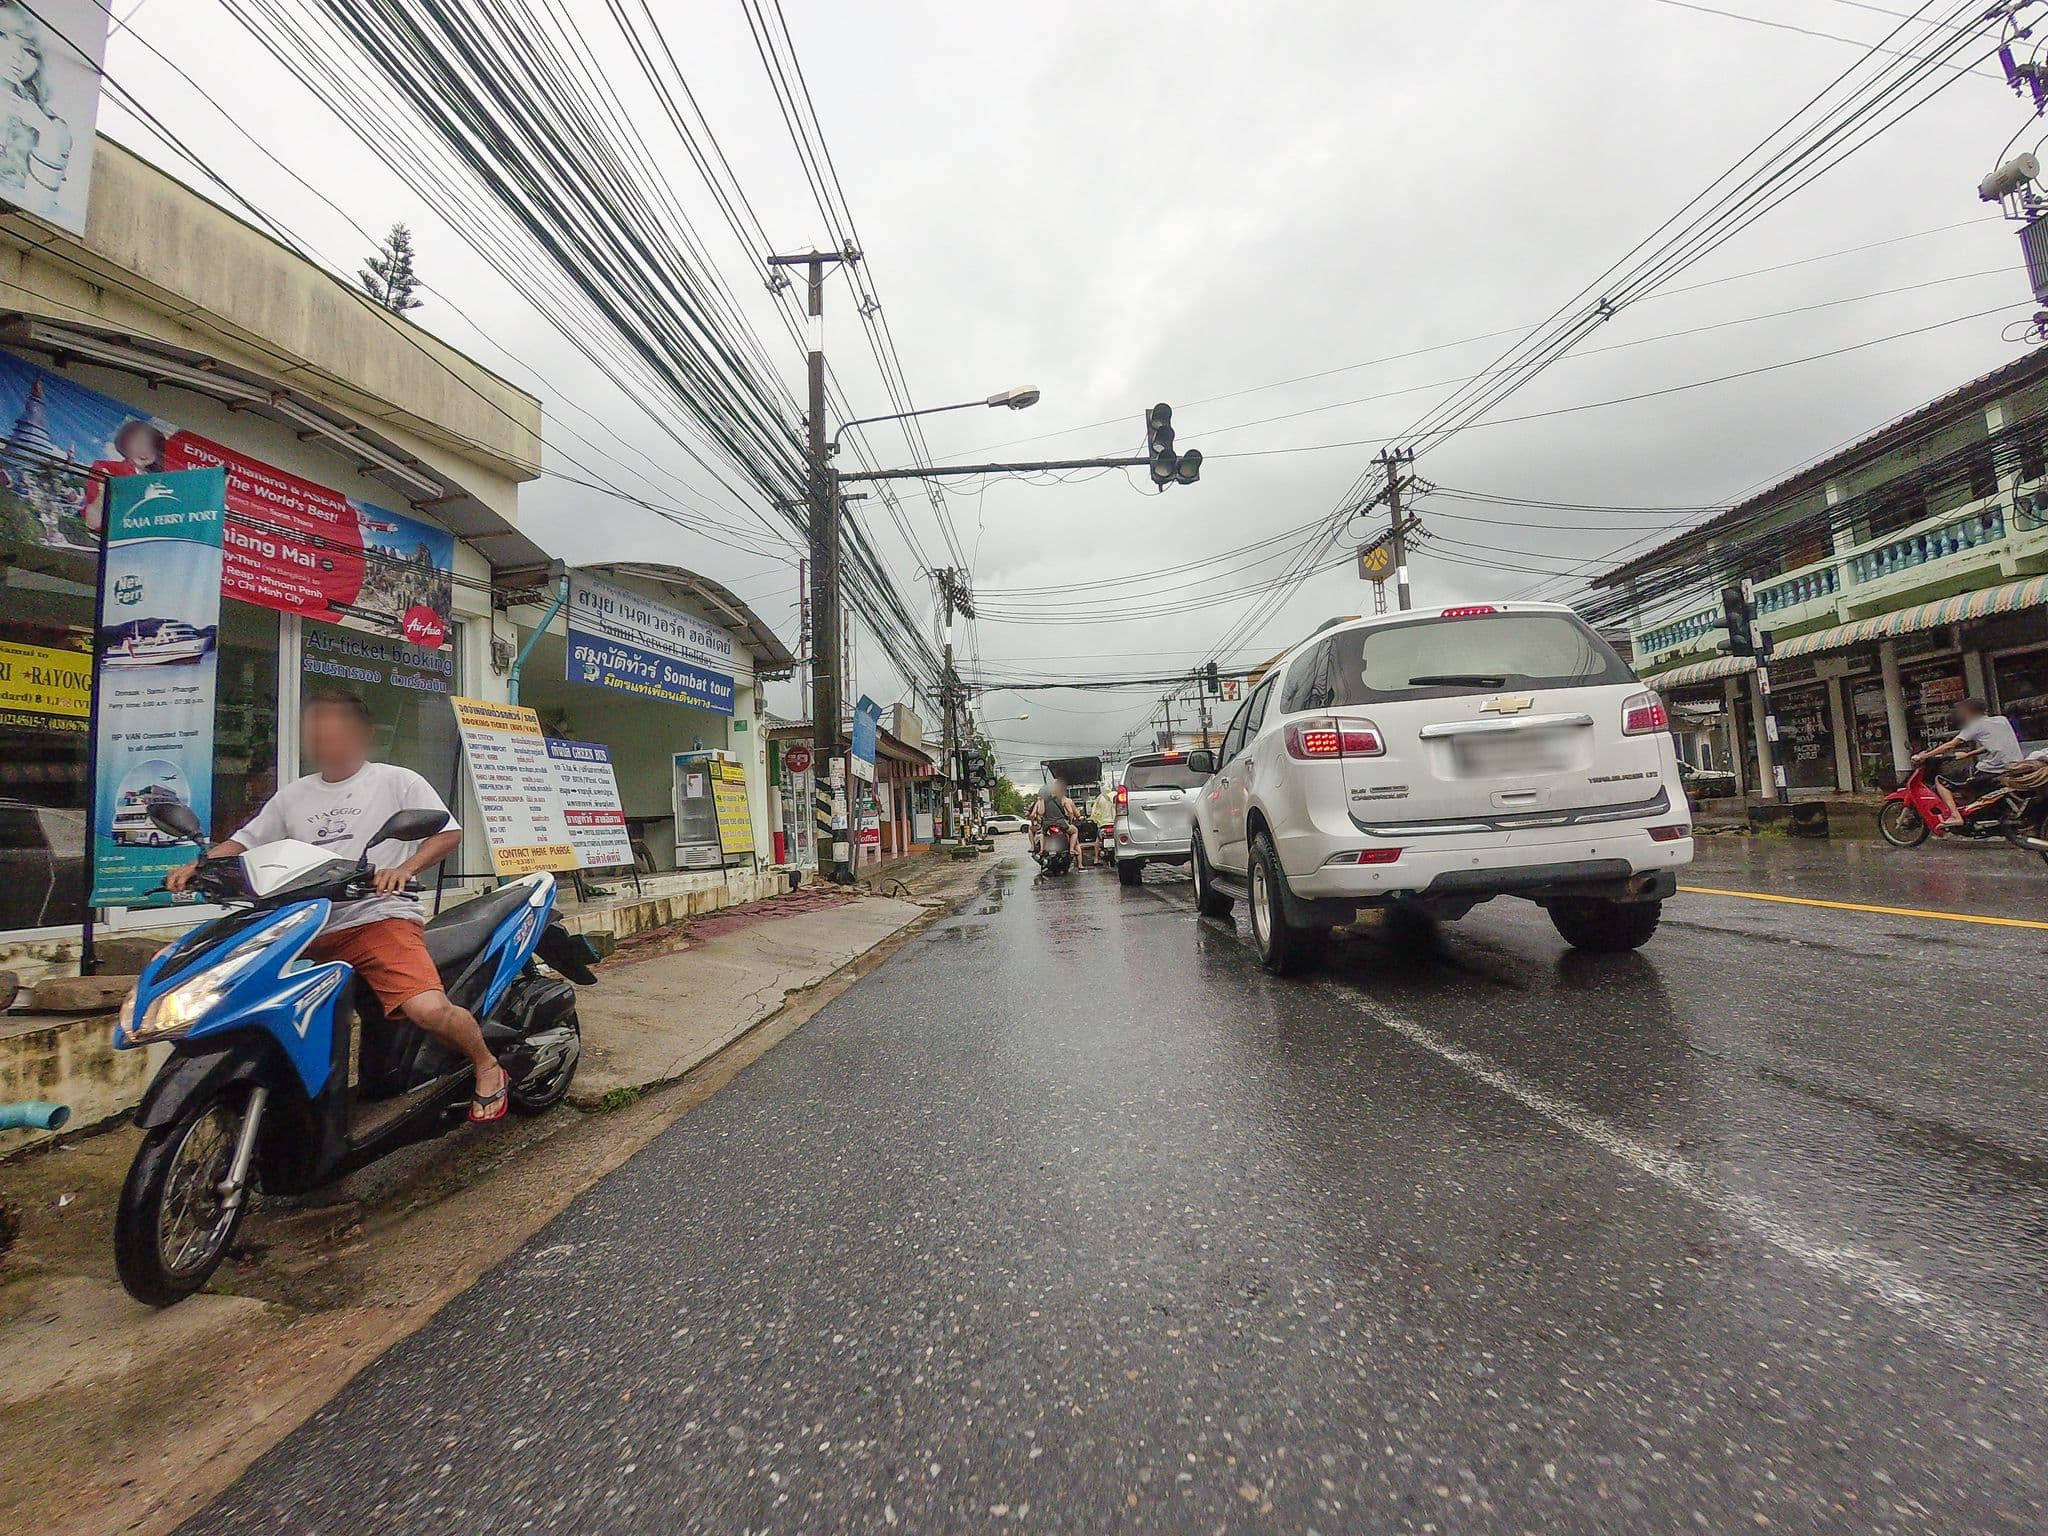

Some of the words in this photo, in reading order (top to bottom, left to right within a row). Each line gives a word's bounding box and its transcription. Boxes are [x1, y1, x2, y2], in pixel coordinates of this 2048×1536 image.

[184, 443, 225, 468] Enjoy
[254, 485, 305, 512] World's
[308, 505, 338, 523] Best!
[154, 513, 186, 526] FERRY
[189, 510, 218, 522] PORT
[282, 545, 316, 568] Mai
[227, 566, 254, 581] Reap
[262, 576, 297, 592] Phnom
[299, 583, 323, 599] Penh
[238, 580, 255, 592] Chi
[258, 585, 283, 599] Minh
[285, 592, 304, 605] City
[579, 589, 614, 618] สมุย
[308, 630, 334, 652] Air
[340, 636, 390, 660] ticket
[392, 645, 454, 677] booking
[32, 666, 93, 692] RAYONG
[574, 645, 660, 679] สมบัติทัวร์
[664, 665, 707, 692] Sombat
[710, 681, 731, 698] tour
[1920, 727, 1949, 737] HOME
[594, 749, 607, 762] BUS
[306, 807, 362, 824] PIAGGIO
[499, 847, 530, 859] CONTACT
[531, 847, 548, 856] HERE
[549, 845, 572, 855] PLEASE
